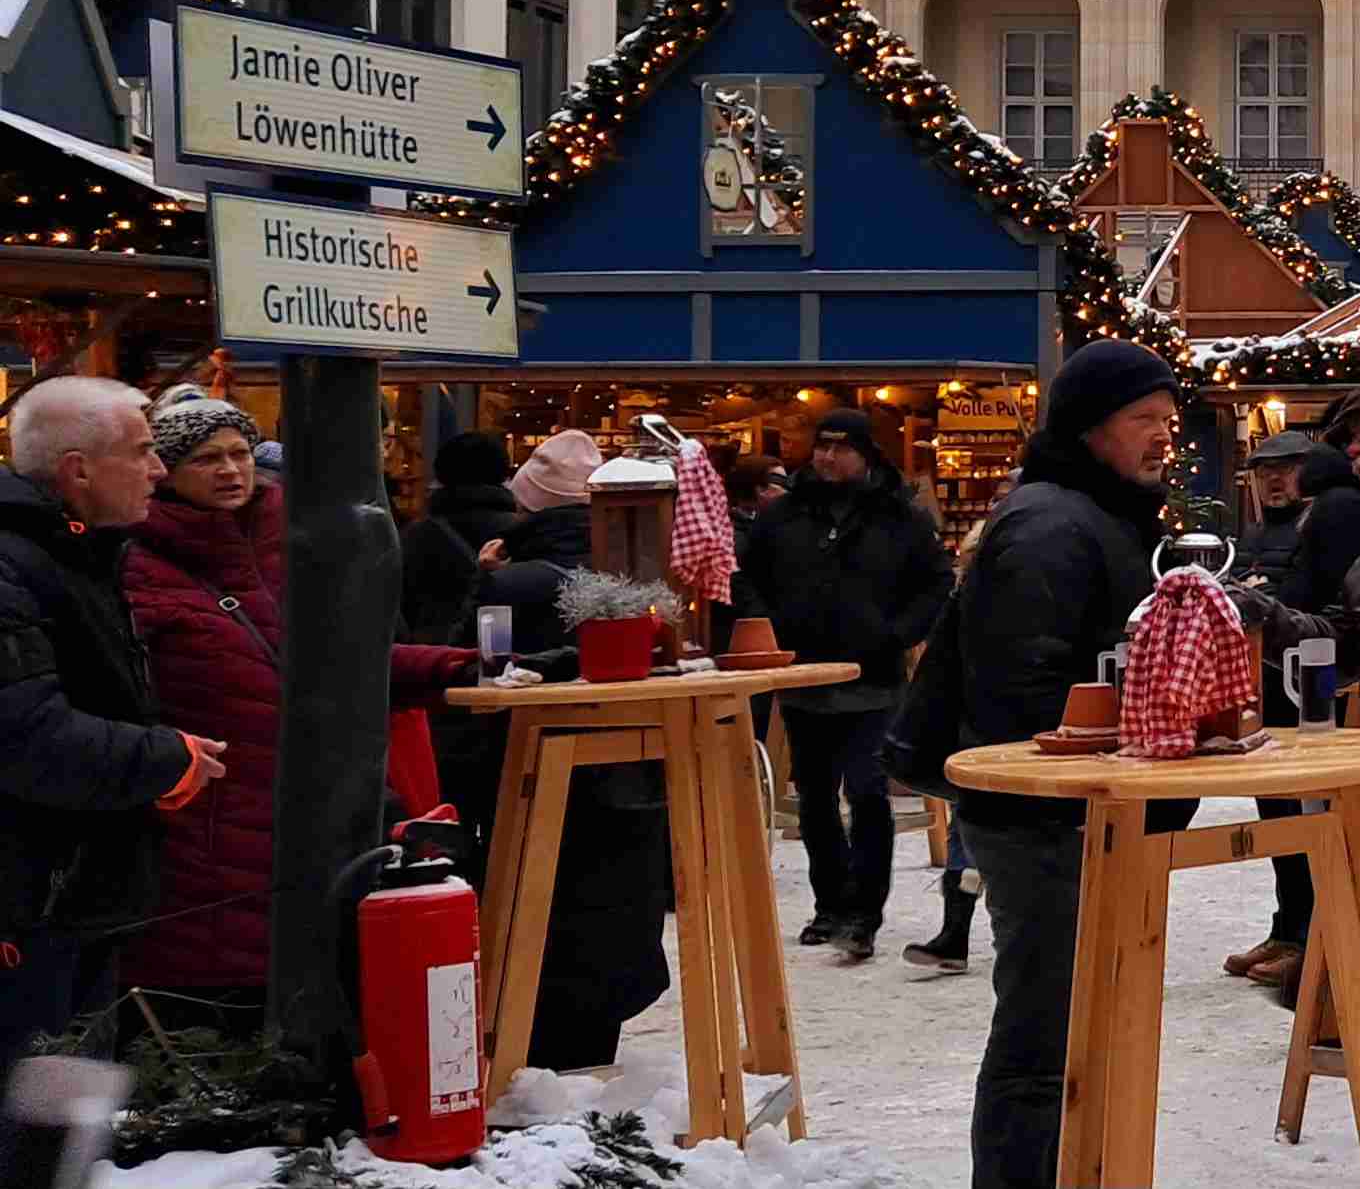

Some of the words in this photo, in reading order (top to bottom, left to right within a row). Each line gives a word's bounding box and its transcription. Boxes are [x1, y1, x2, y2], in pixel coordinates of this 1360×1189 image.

[229, 34, 320, 87] Jamie
[331, 53, 420, 104] Oliver
[235, 101, 418, 164] Löwenhütte
[264, 218, 419, 273] Historische
[263, 285, 428, 335] Grillkutsche
[951, 400, 992, 417] Volle
